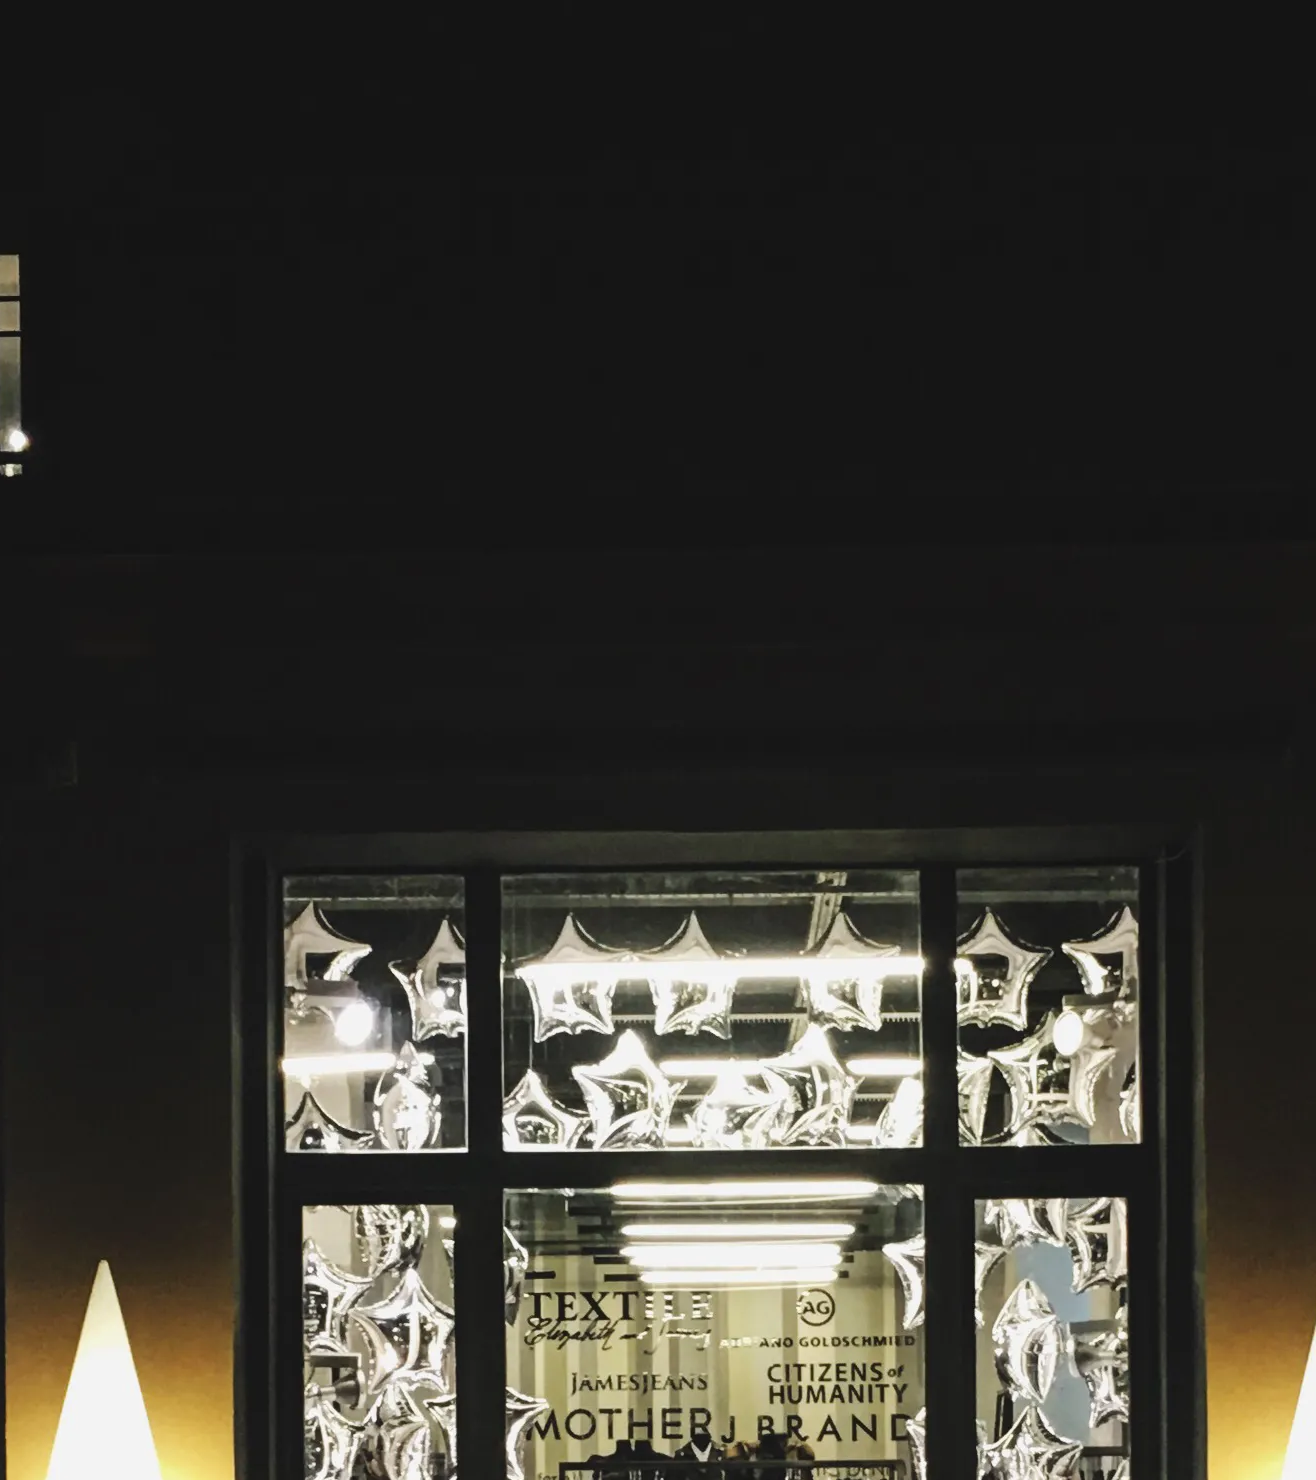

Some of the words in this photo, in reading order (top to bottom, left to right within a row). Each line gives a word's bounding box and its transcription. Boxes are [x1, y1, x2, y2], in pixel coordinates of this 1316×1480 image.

[802, 1300, 830, 1315] AG
[799, 1335, 916, 1348] GOLDSCHMIED
[767, 1363, 884, 1382] CITIZENS
[887, 1365, 905, 1378] of
[769, 1384, 908, 1404] HUMANITY
[526, 1408, 711, 1441] MOTHER
[721, 1415, 735, 1443] J
[758, 1414, 912, 1442] BRAND
